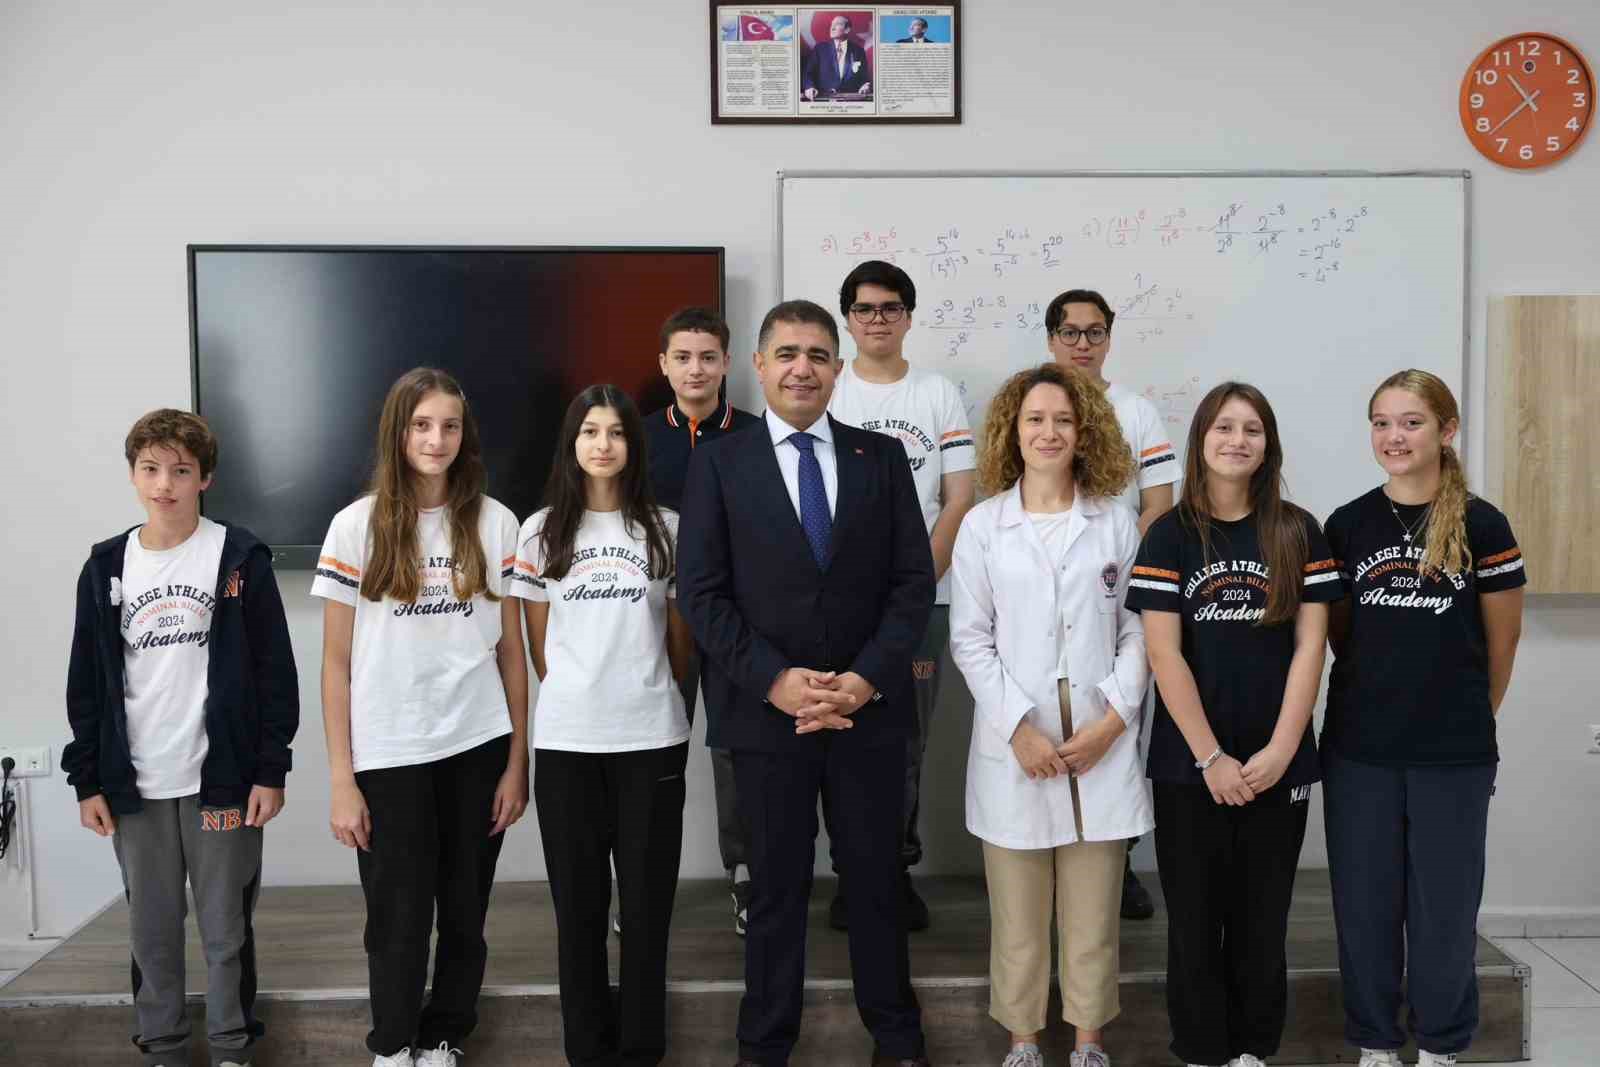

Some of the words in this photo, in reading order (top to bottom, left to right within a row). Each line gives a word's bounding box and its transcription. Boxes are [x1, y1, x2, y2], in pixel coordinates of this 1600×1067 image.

[1518, 41, 1541, 56] 12
[1493, 51, 1511, 66] 11
[1554, 51, 1561, 65] 1
[1474, 70, 1498, 85] 10
[1567, 69, 1580, 84] 2
[1470, 93, 1484, 109] 9
[1572, 92, 1585, 108] 3
[1476, 117, 1490, 132] 8
[1565, 116, 1580, 132] 4
[1496, 138, 1509, 152] 7
[1546, 136, 1560, 152] 5
[1520, 145, 1533, 160] 6
[885, 419, 936, 452] ATHLETICS
[1355, 546, 1401, 582] COLLEGE
[1368, 561, 1415, 580] NOMINAL
[591, 572, 619, 583] 2024
[1184, 560, 1228, 599] COLLEGE
[1391, 576, 1422, 588] 2024
[421, 585, 449, 597] 2024
[563, 584, 647, 603] Academy
[1222, 589, 1251, 601] 2024
[394, 598, 474, 617] Academy
[1360, 587, 1455, 615] Academy
[157, 614, 185, 628] 2024
[200, 808, 241, 832] NB
